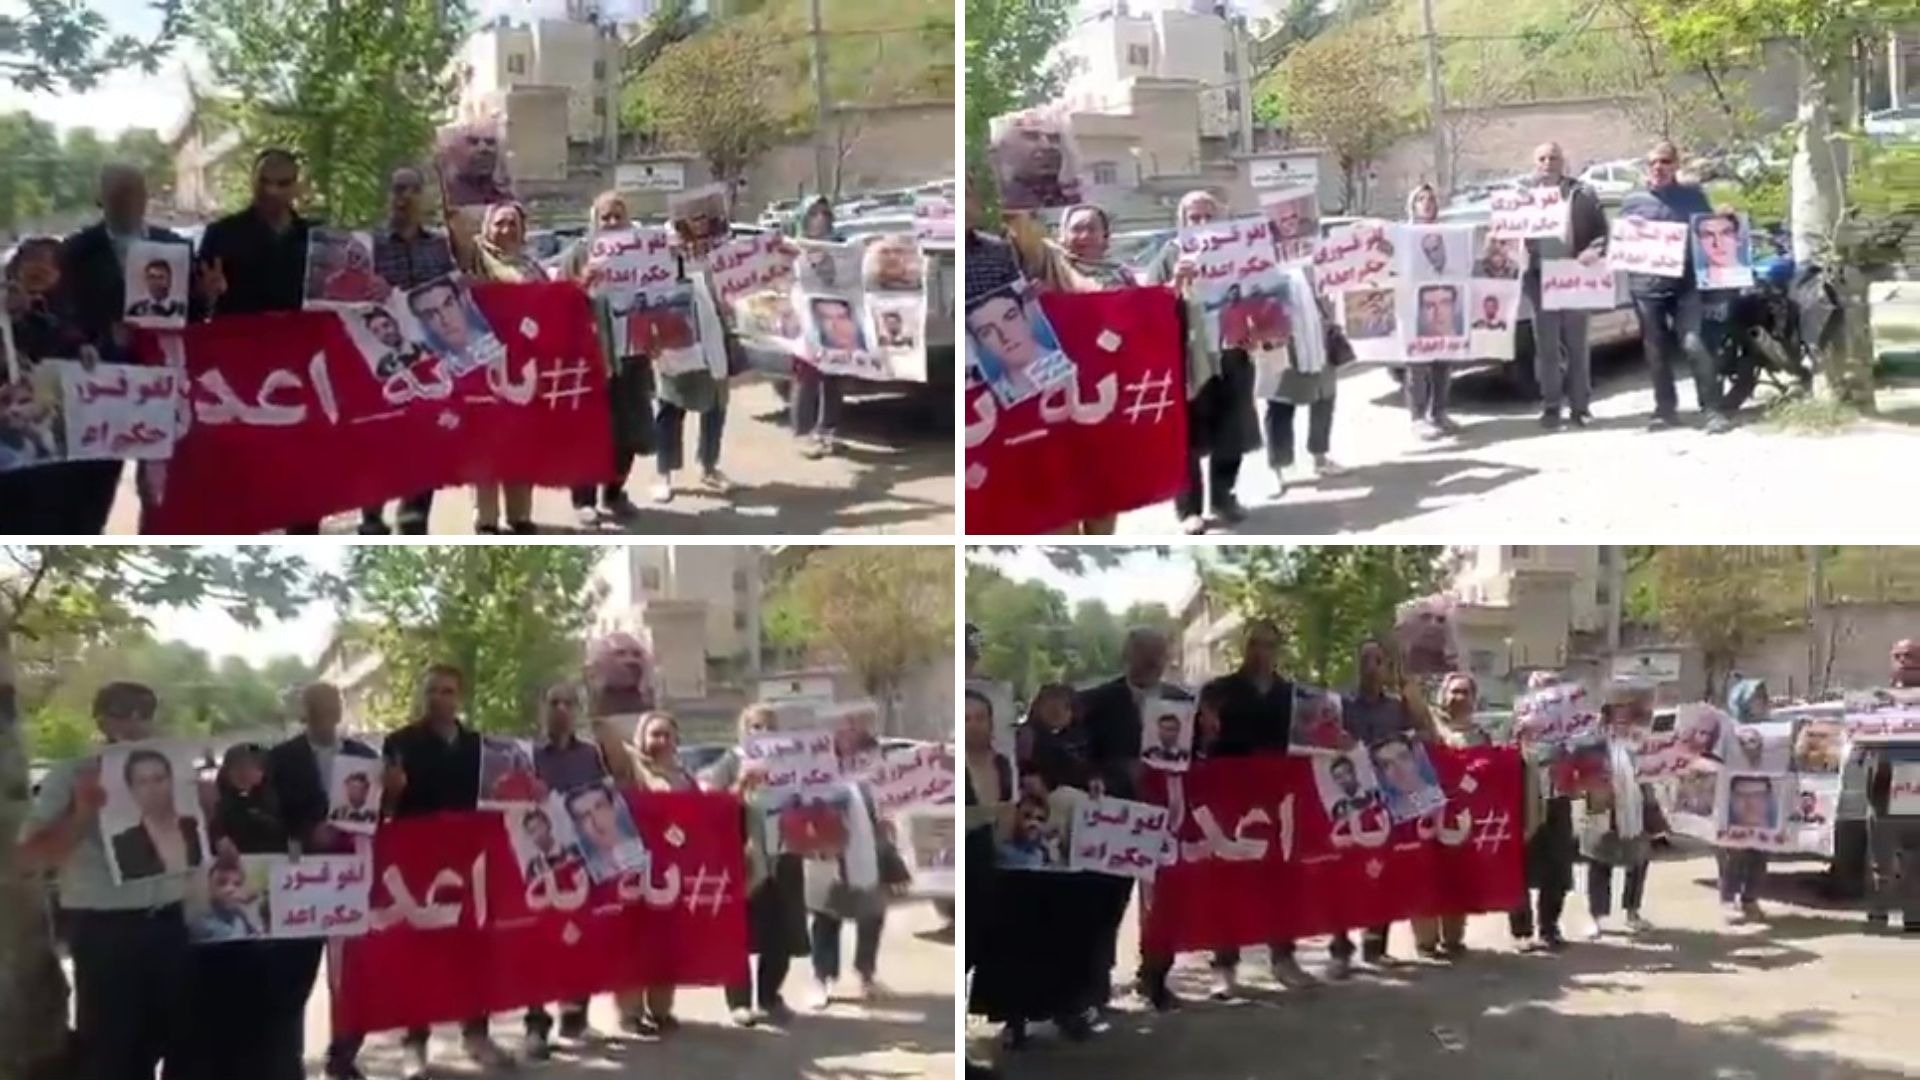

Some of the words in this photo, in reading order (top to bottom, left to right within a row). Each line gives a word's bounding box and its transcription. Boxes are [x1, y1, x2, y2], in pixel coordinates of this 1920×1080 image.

[592, 232, 642, 257] فوری
[648, 231, 667, 255] لغو
[1182, 224, 1241, 253] فوری
[1246, 222, 1267, 248] لغو
[1312, 233, 1361, 266] فوری
[640, 265, 670, 288] حکم
[1194, 261, 1235, 280] اعدا
[1239, 256, 1274, 280] حکم
[1358, 259, 1386, 283] حکم
[1544, 275, 1581, 294] اعدام
[135, 374, 174, 406] لغو
[111, 421, 167, 452] حکم
[763, 769, 796, 788] اعدا
[1131, 813, 1166, 835] لغو
[1107, 847, 1154, 868] حکم
[281, 861, 330, 890] فور
[337, 863, 365, 890] لغو
[282, 904, 317, 926] اعد
[321, 903, 363, 930] حکم
